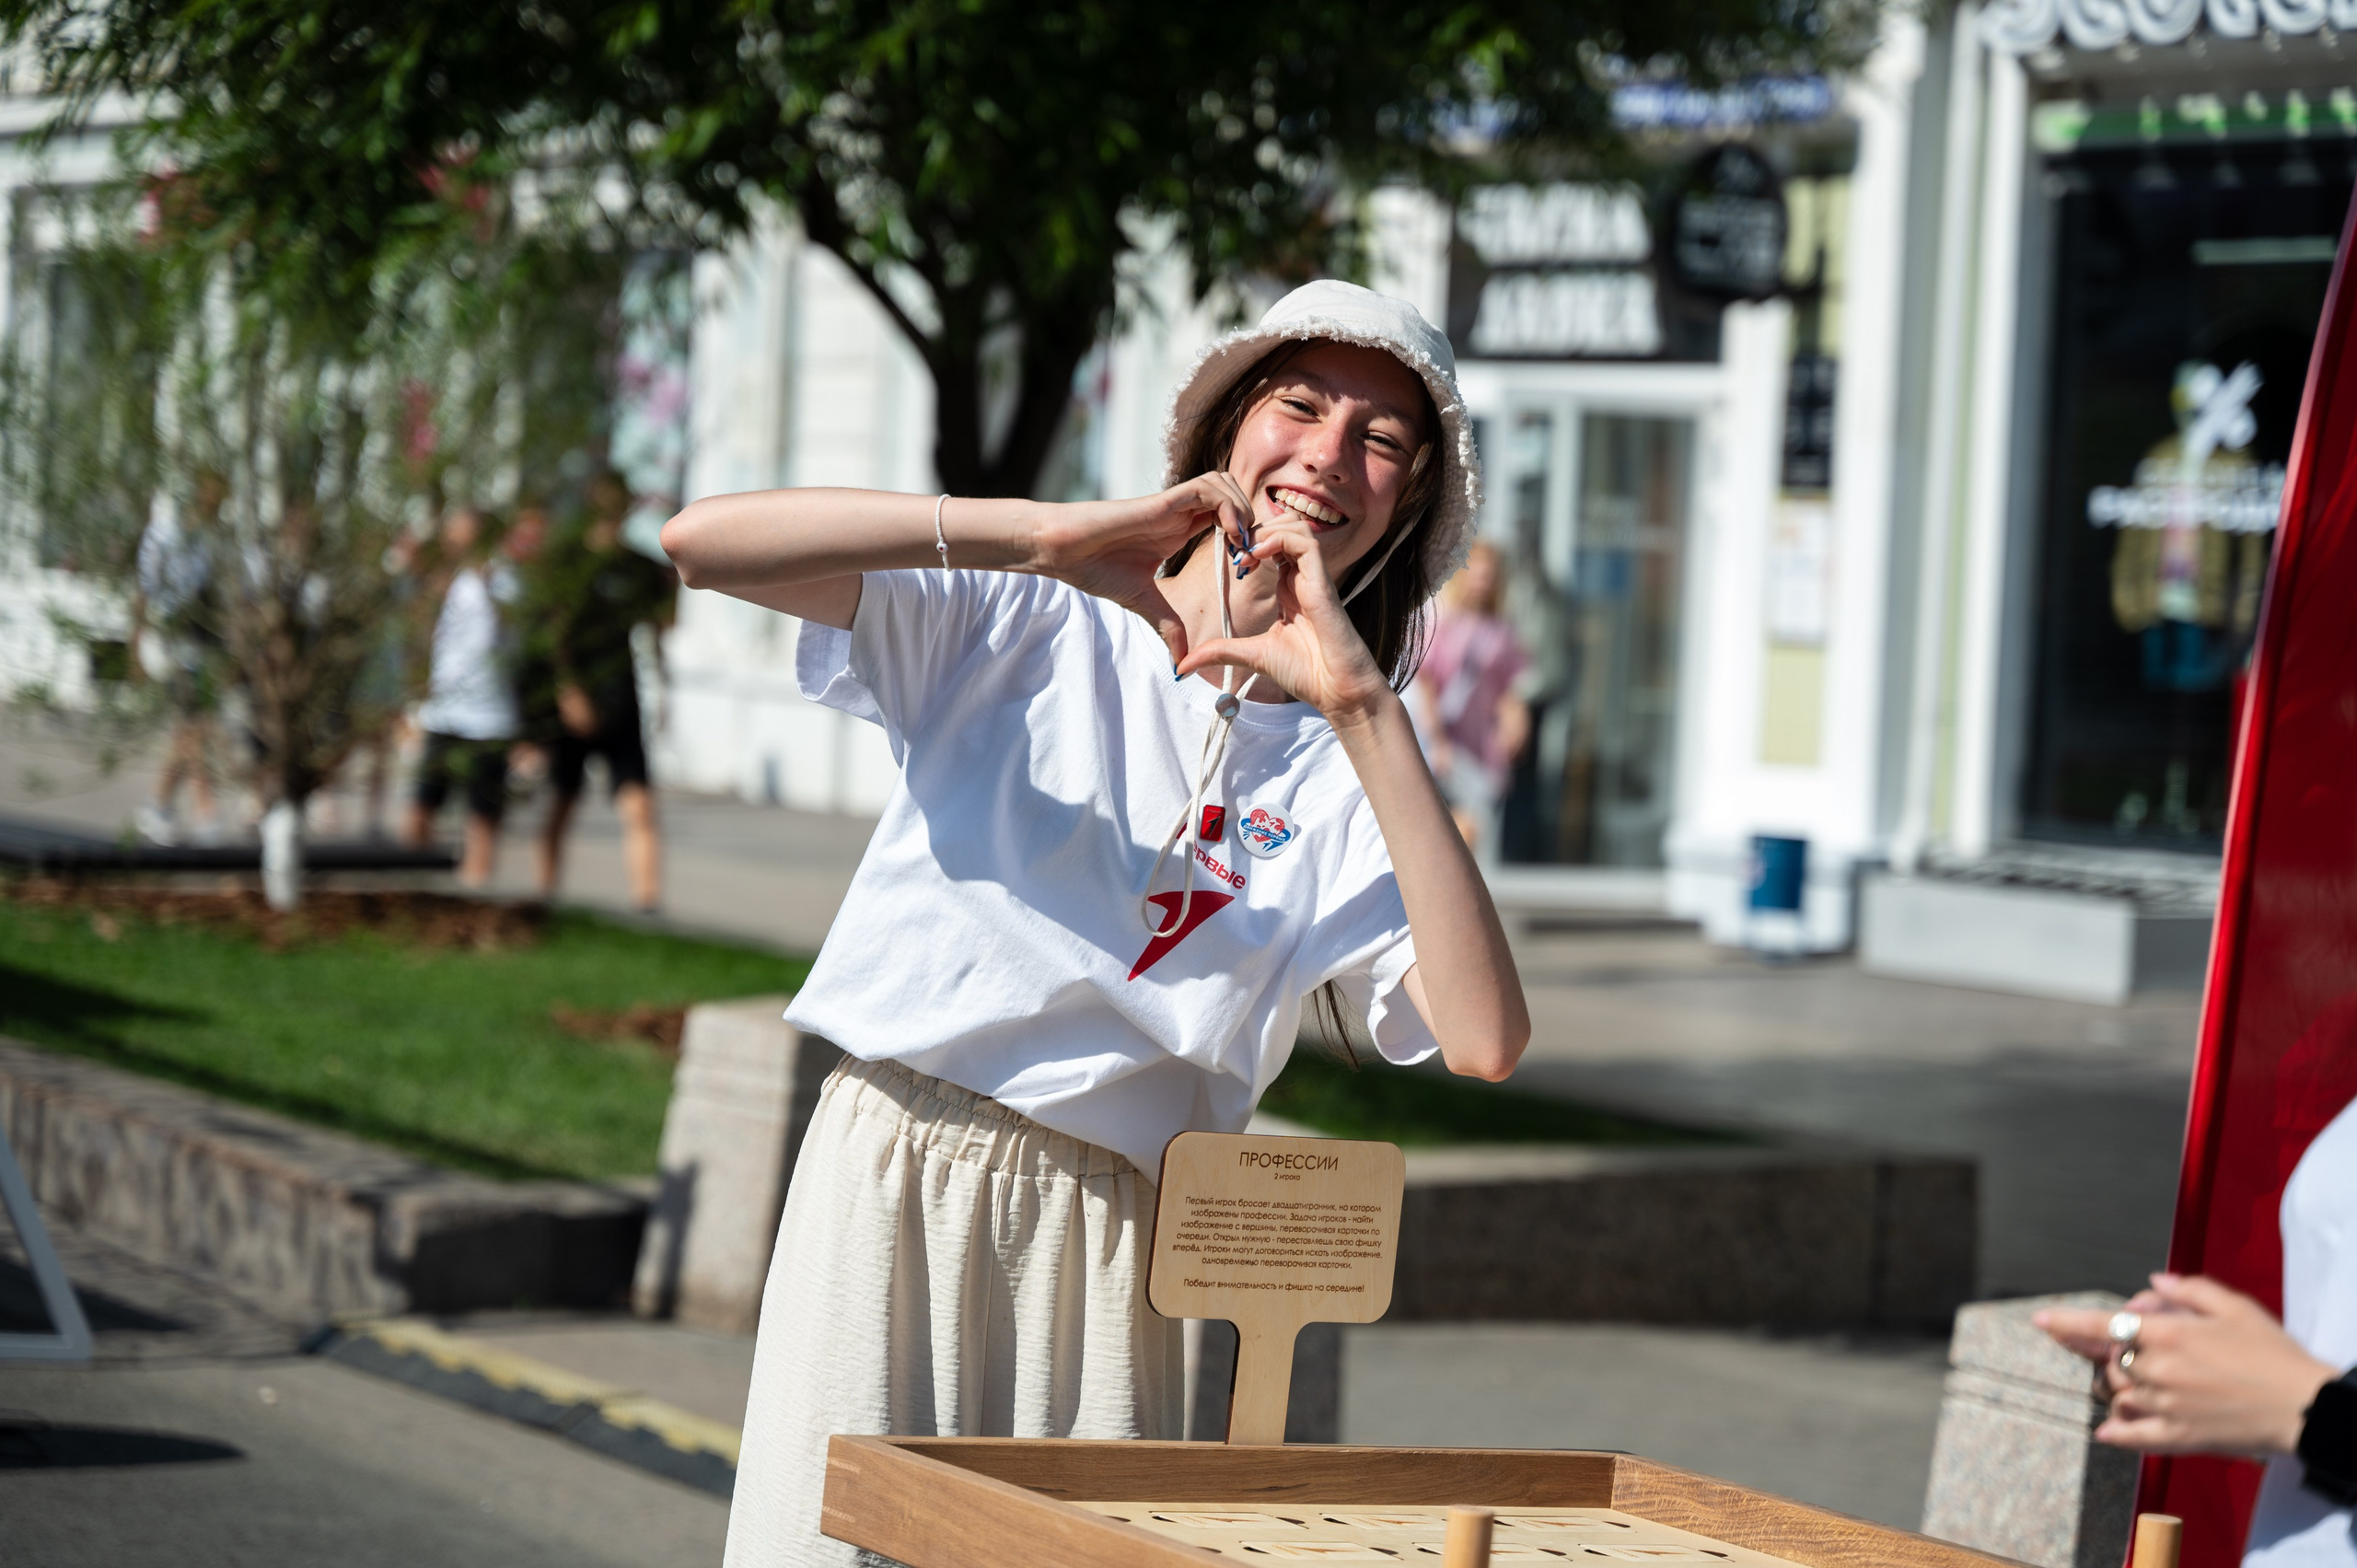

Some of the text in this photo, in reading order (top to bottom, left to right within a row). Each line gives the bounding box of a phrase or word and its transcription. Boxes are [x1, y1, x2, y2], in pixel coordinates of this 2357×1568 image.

[1239, 1152, 1339, 1170] ПРОФЕССИИ
[1185, 1196, 1214, 1206] Первый
[1215, 1199, 1237, 1207] игрок
[1238, 1199, 1271, 1208] бросает
[1271, 1202, 1337, 1211] двадцатигранник,
[1350, 1205, 1381, 1214] котором
[1190, 1209, 1239, 1218] изображены
[1240, 1212, 1287, 1221] профессии.
[1289, 1213, 1317, 1222] Задача
[1318, 1215, 1347, 1224] игроков
[1181, 1220, 1234, 1230] изображение
[1280, 1225, 1336, 1234] переворачивая
[1337, 1227, 1370, 1236] карточки
[1213, 1232, 1240, 1242] Открыл
[1241, 1235, 1271, 1244] нужную
[1276, 1237, 1333, 1246] переставляешь
[1355, 1239, 1382, 1249] фишку
[1172, 1244, 1202, 1252] вперёд.
[1203, 1245, 1231, 1253] Игроки
[1255, 1248, 1304, 1257] договориться
[1330, 1249, 1382, 1259] изображение,
[1201, 1257, 1353, 1270] одновременно переворачивая карточки.
[1183, 1278, 1216, 1288] Победит
[1217, 1281, 1277, 1290] внимательность
[1284, 1283, 1313, 1292] фишка
[1326, 1284, 1364, 1294] середине!
